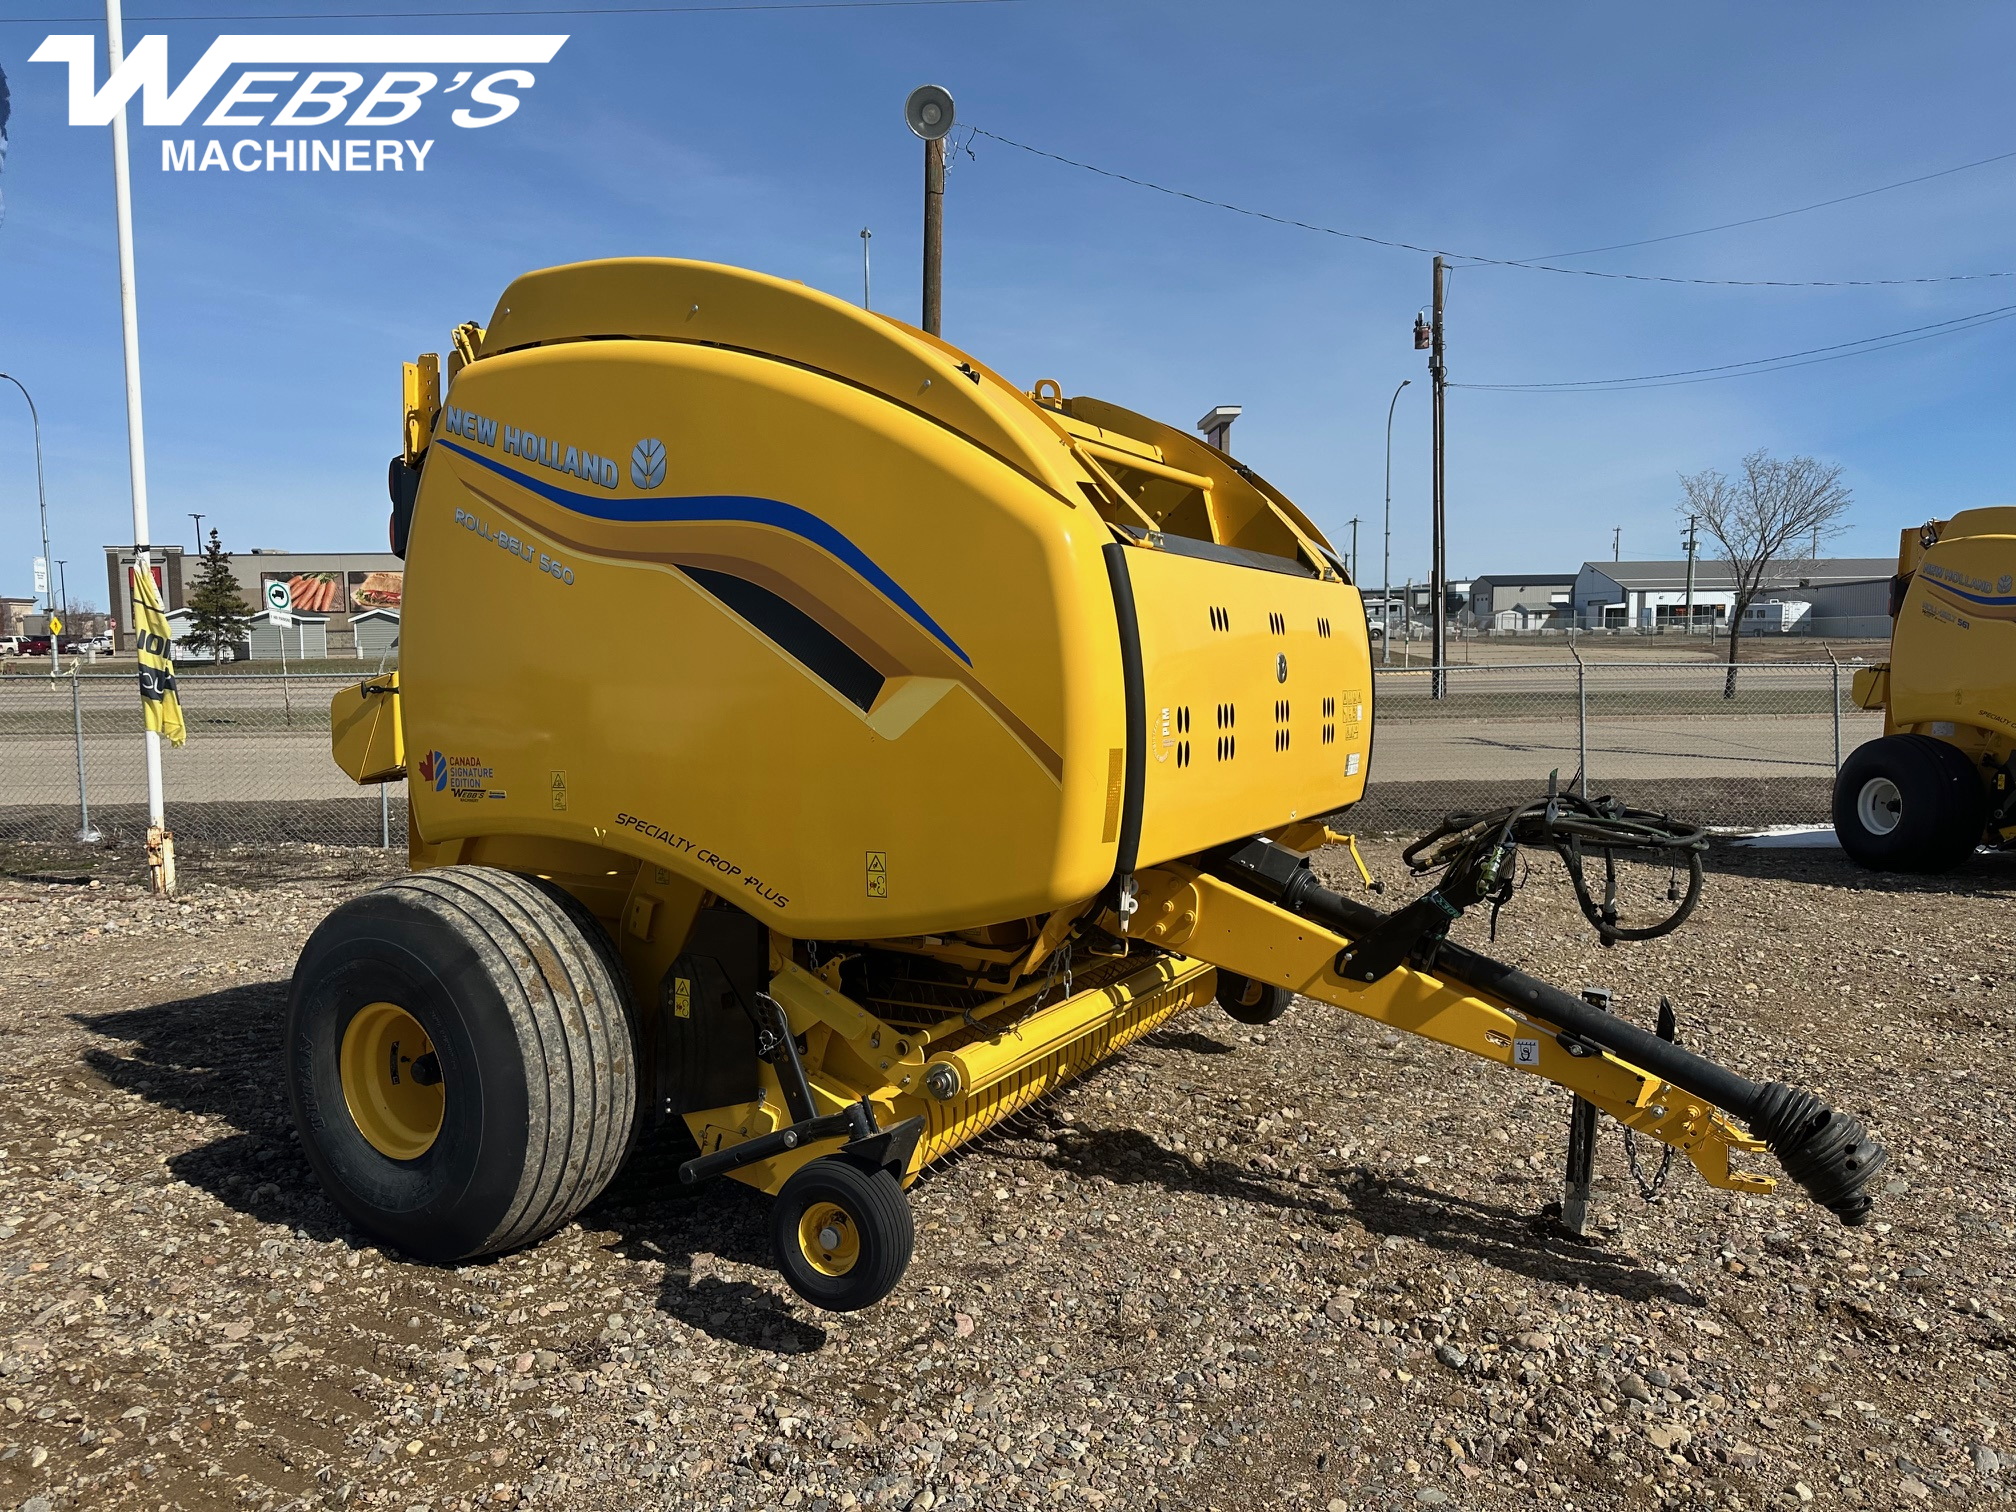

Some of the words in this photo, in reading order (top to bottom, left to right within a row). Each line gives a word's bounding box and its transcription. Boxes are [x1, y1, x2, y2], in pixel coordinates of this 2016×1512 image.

[446, 405, 498, 447] NEW
[503, 424, 619, 490] HOLLAND
[455, 507, 535, 563] ROLL-BELT
[539, 553, 575, 586] 560
[1945, 568, 1993, 594] HOLLAND
[1161, 707, 1170, 737] PLM
[1978, 709, 2012, 725] SPECIALTY
[449, 756, 482, 767] CANADA
[450, 767, 494, 778] SIGNATURE
[450, 777, 481, 788] EDITION
[615, 813, 696, 853] SPECIALTY
[697, 850, 742, 876] CROP
